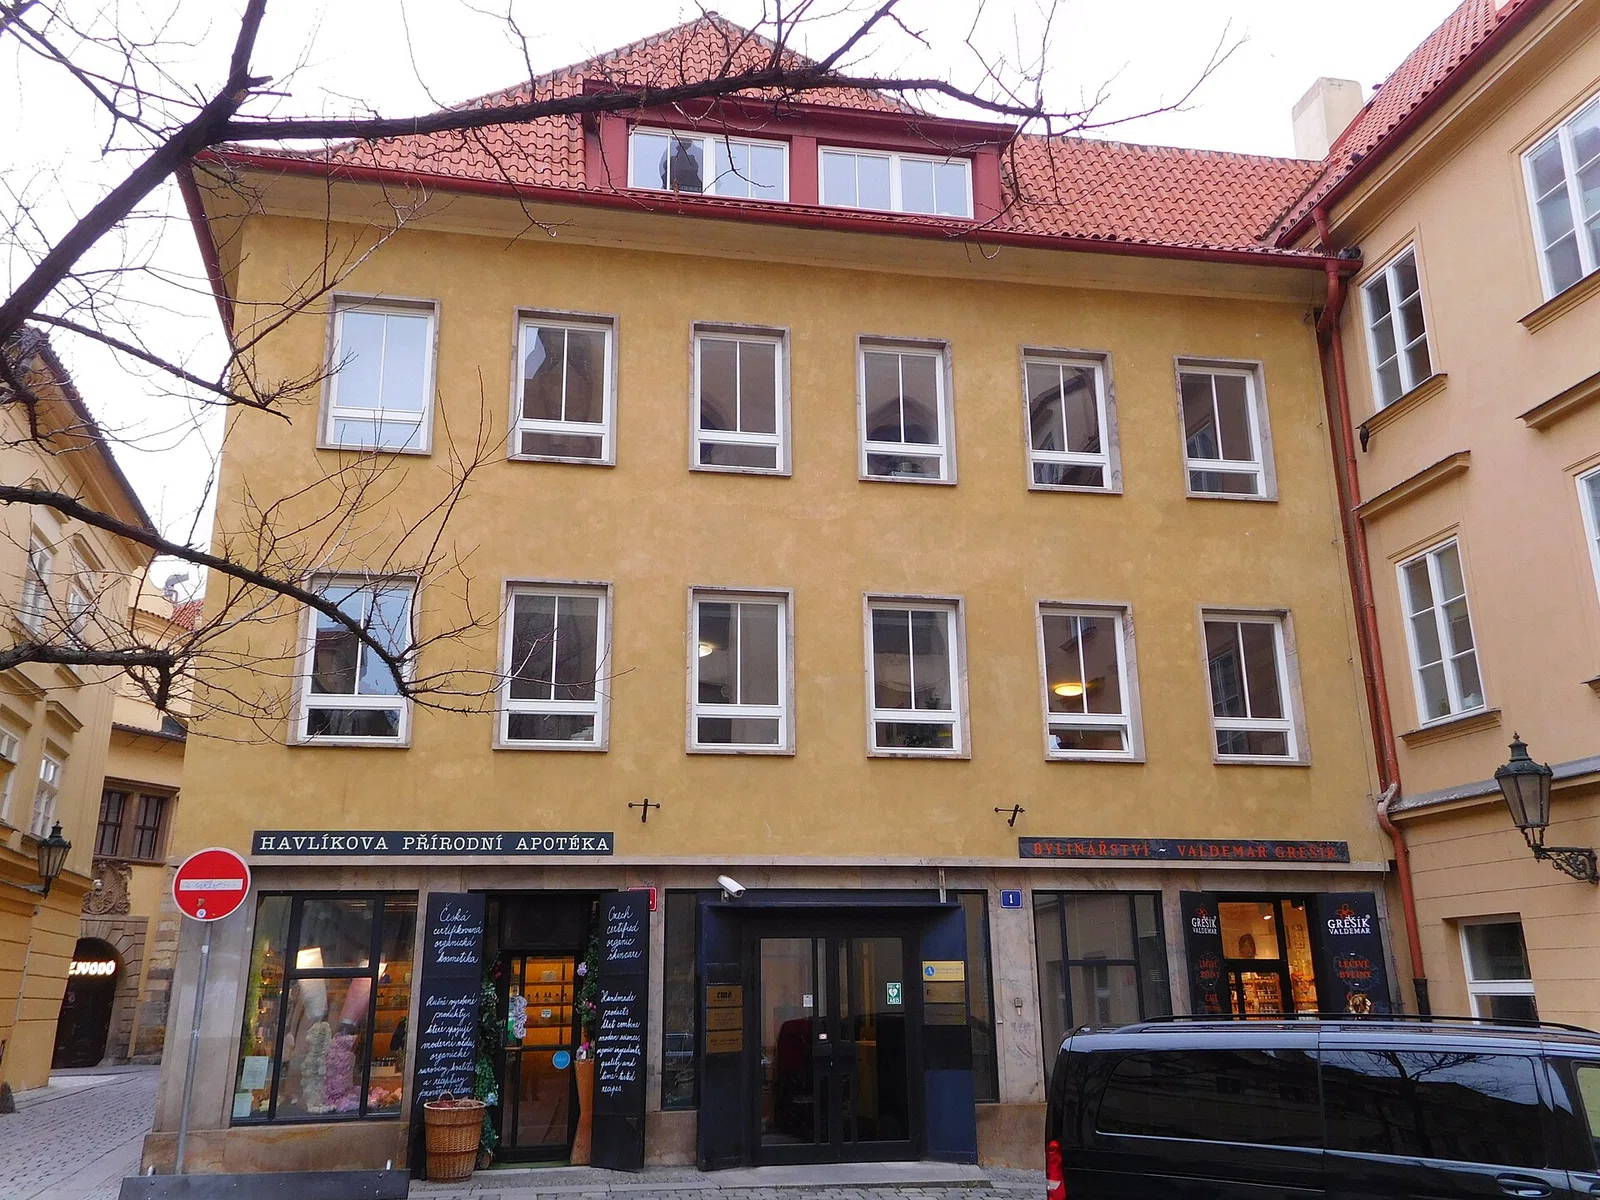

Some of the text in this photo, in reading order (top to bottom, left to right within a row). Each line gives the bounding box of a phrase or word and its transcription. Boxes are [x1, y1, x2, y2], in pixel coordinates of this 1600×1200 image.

[259, 834, 610, 851] HAVLÍKOVA PŘÍRODNÍ APOTÉKA
[1033, 841, 1149, 857] BYLINÁŘSTVÍ
[1177, 845, 1267, 858] VALDEMAR
[1009, 894, 1013, 904] 1
[440, 902, 471, 922] Česká
[608, 905, 633, 921] Czech
[606, 921, 640, 939] certified
[434, 936, 476, 954] organická
[606, 937, 635, 952] organic
[436, 951, 479, 963] kosmetika
[607, 949, 642, 961] skincare
[600, 990, 637, 1003] Handmade
[602, 1006, 629, 1021] products
[616, 1018, 641, 1028] combine
[420, 1036, 456, 1049] moderní
[430, 1047, 470, 1066] organické
[621, 1057, 637, 1067] and
